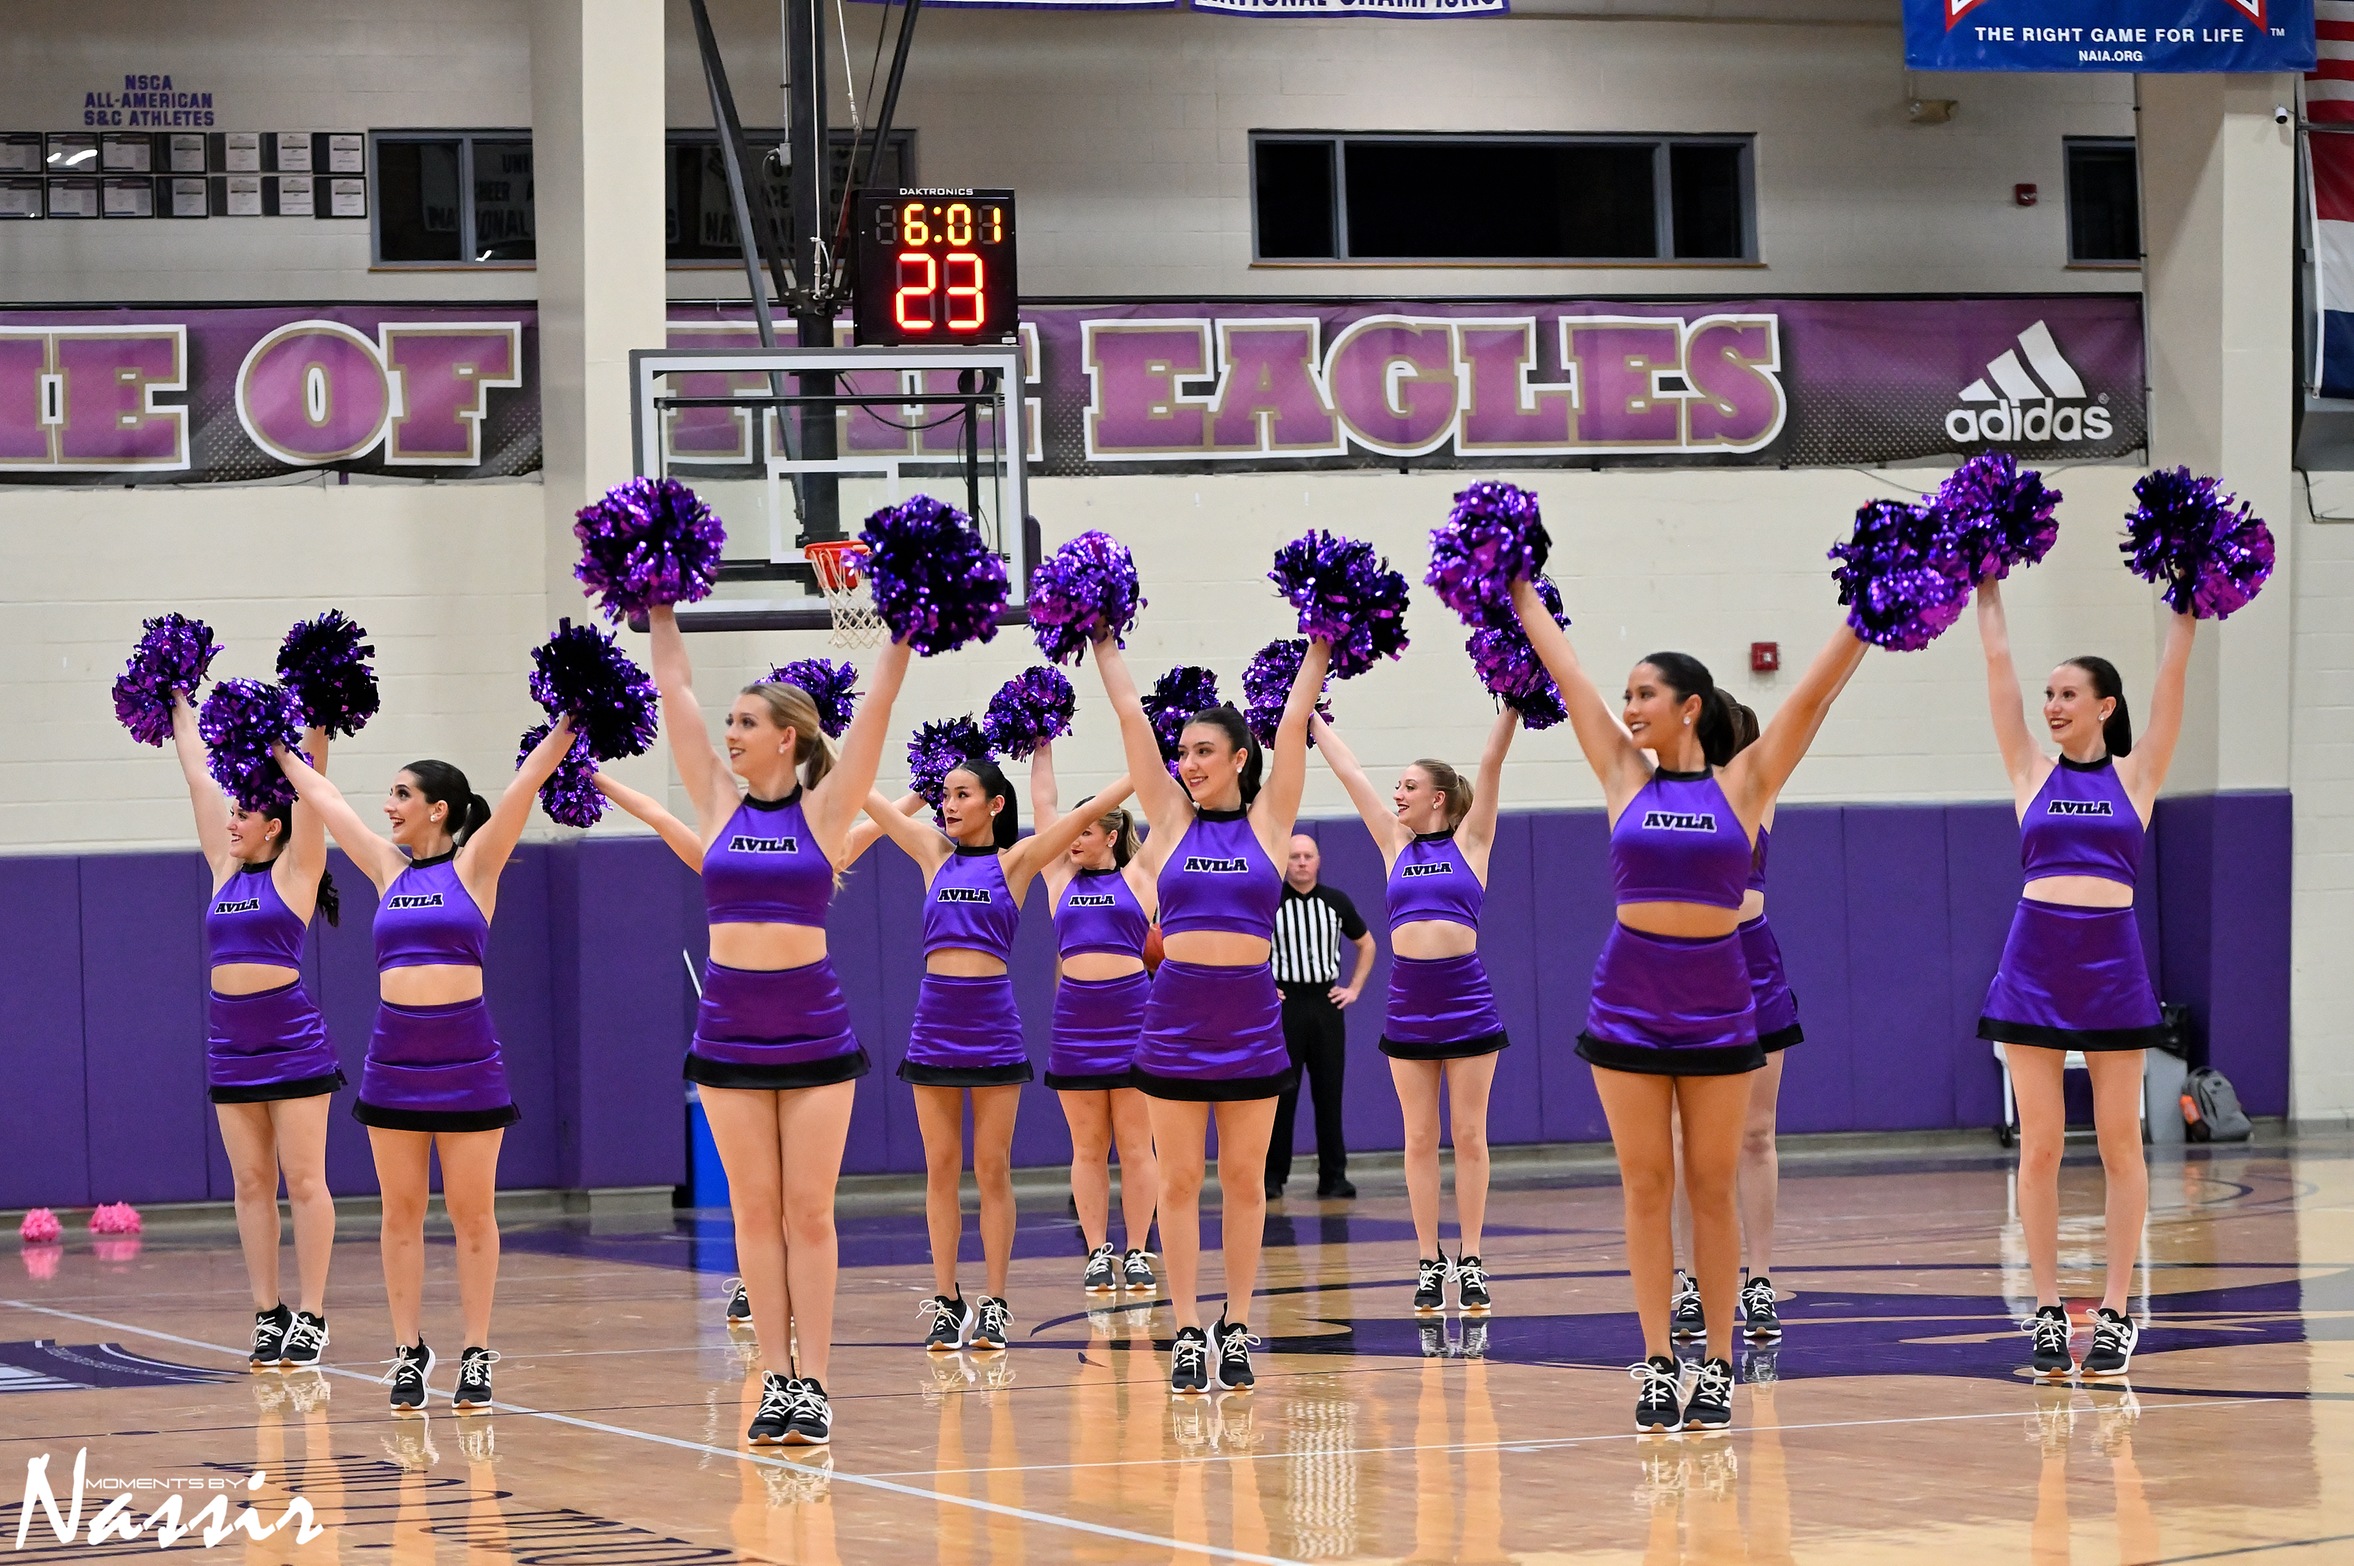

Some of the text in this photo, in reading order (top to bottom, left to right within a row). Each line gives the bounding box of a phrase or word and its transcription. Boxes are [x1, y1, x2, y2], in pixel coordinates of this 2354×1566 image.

[1975, 26, 2014, 42] THE
[2023, 27, 2083, 43] RIGHT
[2090, 28, 2147, 43] GAME
[2156, 28, 2195, 43] FOR
[2203, 28, 2245, 43] LIFE
[2079, 50, 2144, 62] NAIA.ORG
[125, 75, 173, 90] NSCA
[84, 92, 213, 108] ALL-AMERICAN
[84, 110, 215, 126] S&C ATHLETES
[899, 187, 974, 196] DAKTRONICS
[904, 203, 1002, 246] 6:01
[895, 253, 985, 329] 23
[235, 319, 522, 466] OF
[1080, 314, 1787, 461] EAGLES
[1945, 397, 2113, 443] adidas
[2047, 799, 2113, 816] AVILA
[1642, 811, 1717, 833] AVILA
[728, 834, 798, 854] AVILA
[1183, 856, 1249, 874] AVILA
[1401, 861, 1453, 878] AVILA
[387, 893, 443, 910] AVILA
[937, 887, 992, 904] AVILA
[1068, 894, 1116, 907] AVILA
[214, 898, 260, 915] AVILA
